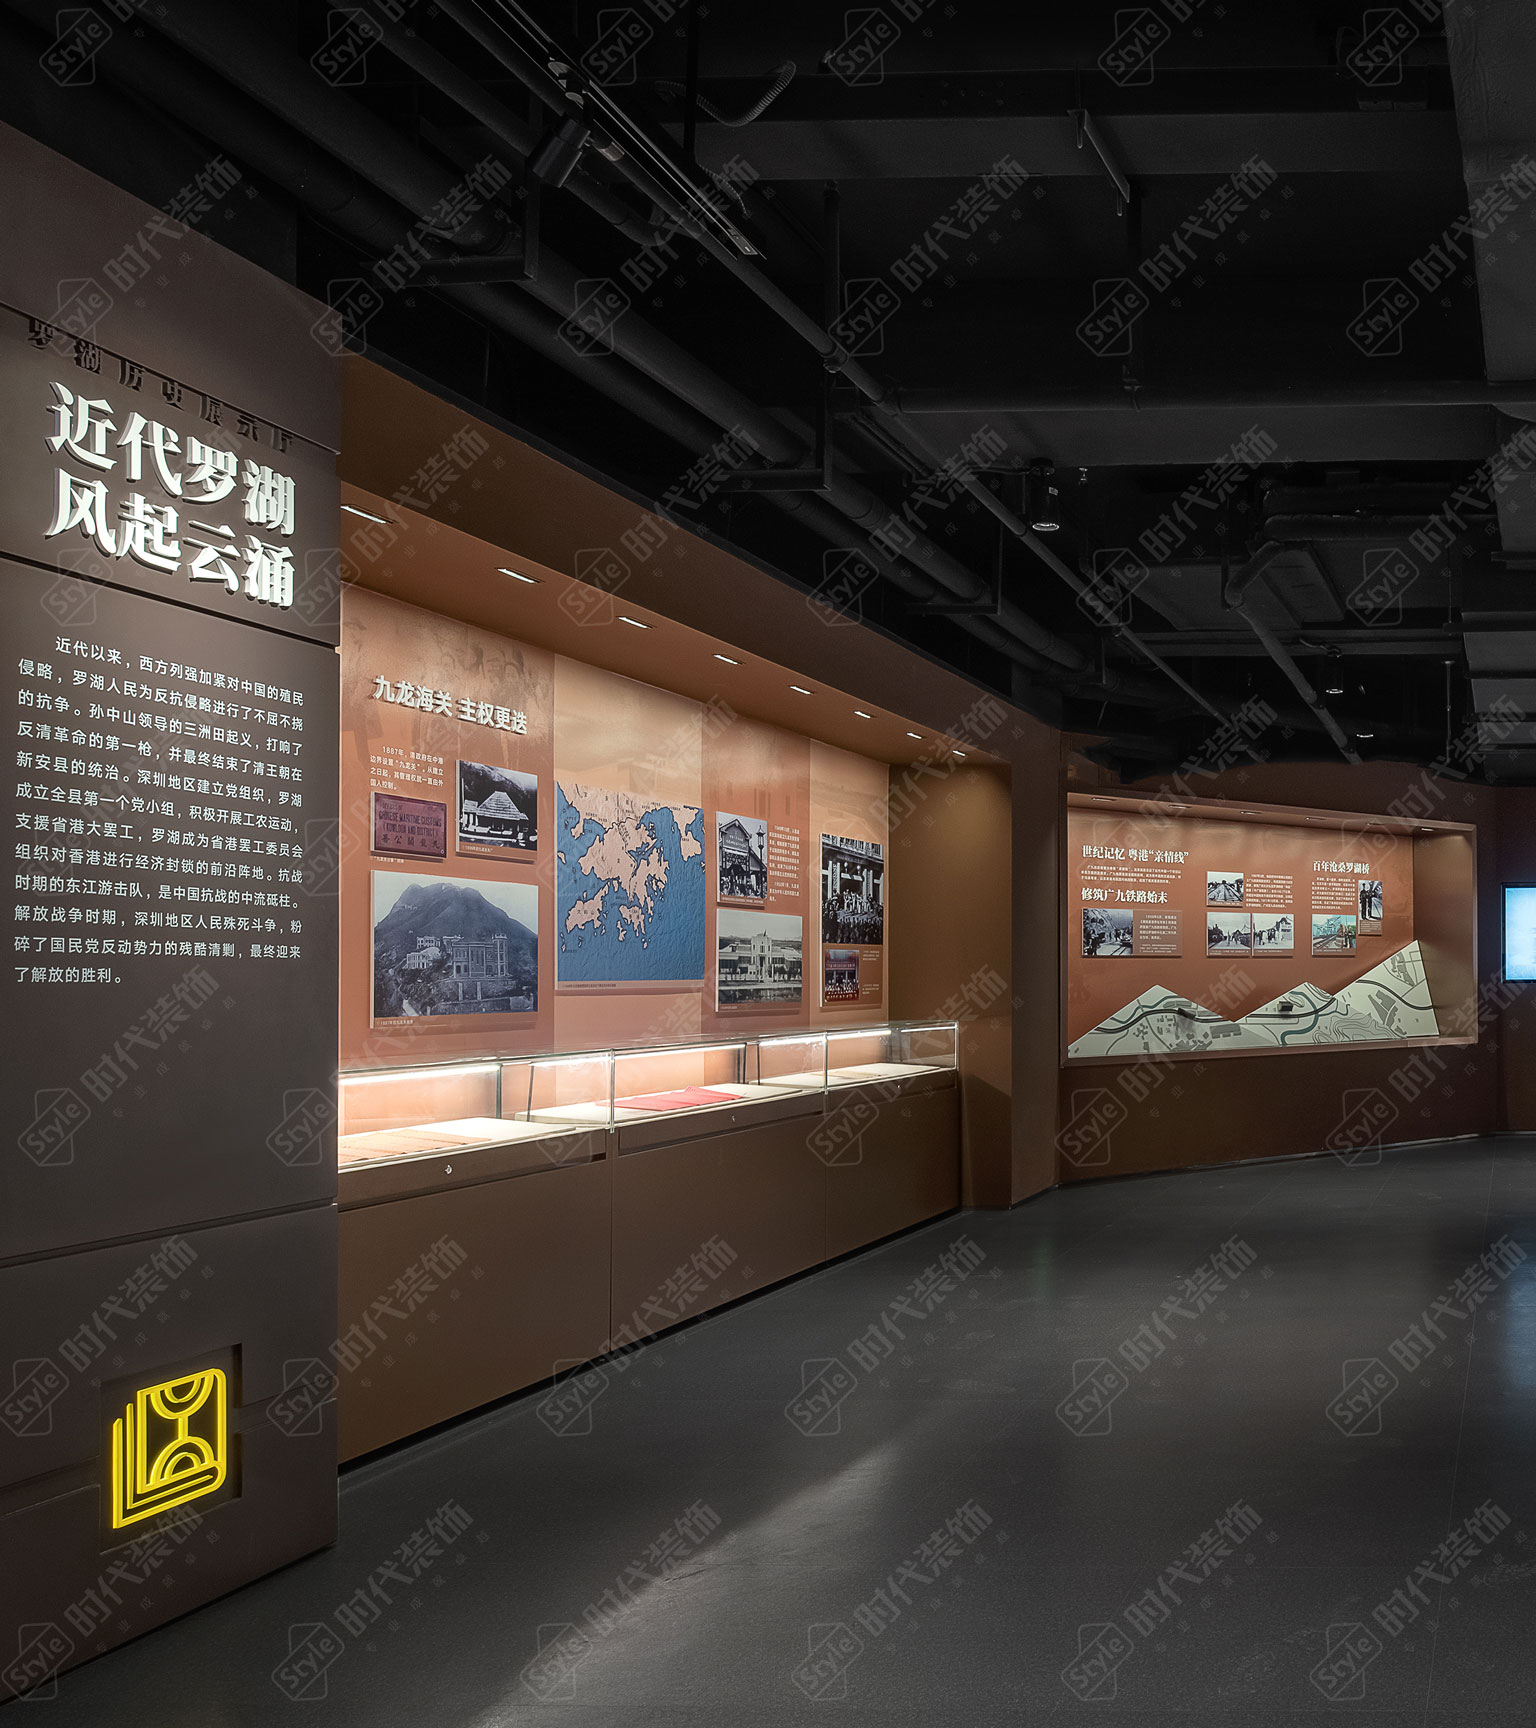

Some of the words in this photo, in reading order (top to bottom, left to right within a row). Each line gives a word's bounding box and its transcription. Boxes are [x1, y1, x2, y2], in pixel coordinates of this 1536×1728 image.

[45, 382, 296, 535] 近代罗湖
[43, 468, 296, 610] 风起云涌
[18, 659, 303, 731] 侵略，罗湖人民为反抗侵略进行了不屈不挠
[55, 636, 304, 706] 近代以来，西方列强加紧对中国的殖民
[18, 689, 303, 755] 的抗争。孙中山领导的三洲田起义，打响了
[372, 675, 452, 717] 九龙海关
[456, 697, 528, 735] 主权更迭
[16, 751, 302, 807] 新安县的统治。深圳地区建立党组织，罗湖
[17, 721, 302, 781] 反清革命的第一枪，并最终结束了清王朝在
[15, 813, 303, 858] 支援省港大罢工，罗湖成为省港罢工委员会
[15, 843, 303, 884] 组织对香港进行经济封锁的前沿阵地。抗战
[1082, 845, 1126, 860] 世纪记忆
[1312, 860, 1370, 875] 百年沧桑罗湖桥
[14, 905, 302, 934] 解放战争时期，深圳地区人民殊死斗争，粉
[1081, 888, 1168, 904] 修筑广九铁路始末
[14, 967, 122, 984] 了解放的胜利。
